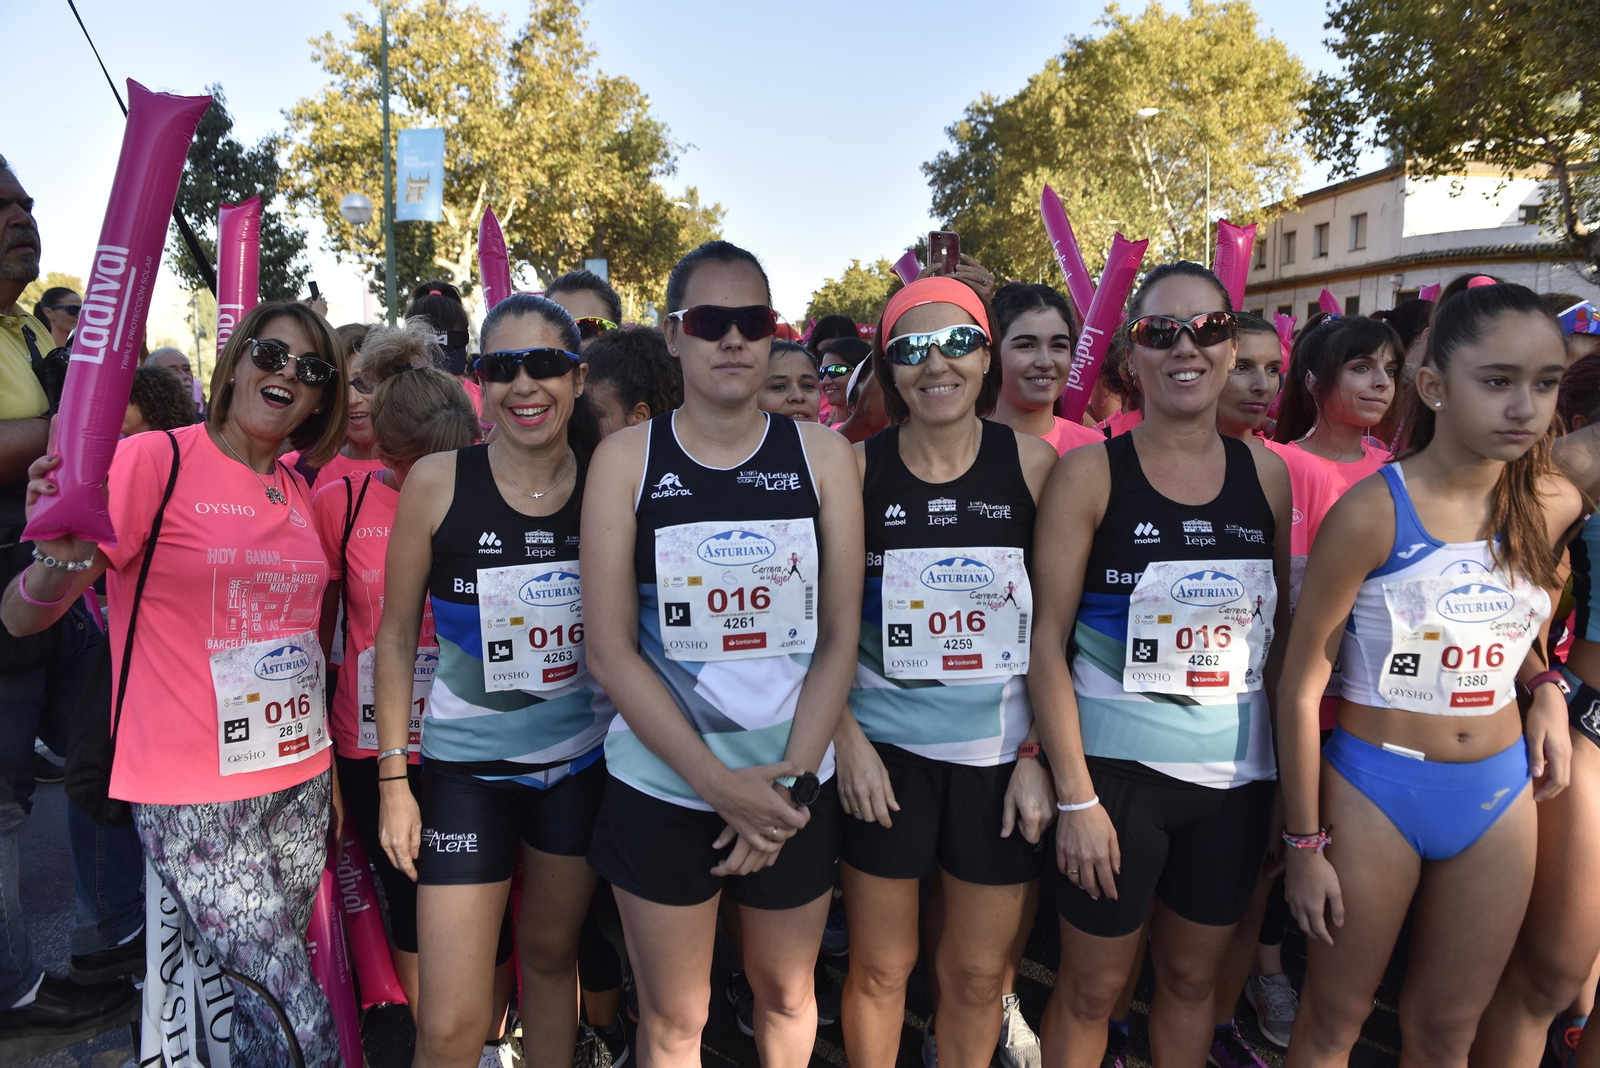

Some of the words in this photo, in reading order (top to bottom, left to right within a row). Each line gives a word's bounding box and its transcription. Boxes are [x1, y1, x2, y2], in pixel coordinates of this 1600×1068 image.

[69, 244, 130, 365] Ladival
[120, 341, 133, 371] TRIPLE
[128, 286, 146, 341] PROTECCIÓN
[142, 255, 153, 285] SOLAR
[1066, 325, 1105, 392] Ladival
[194, 502, 256, 517] OYSHO
[884, 519, 907, 527] mobel
[927, 514, 958, 527] lepe
[1134, 537, 1161, 545] mobel
[1183, 534, 1217, 548] lepe
[206, 548, 238, 565] HOY
[244, 548, 282, 566] GANAN
[524, 546, 556, 559] lepe
[703, 544, 771, 559] ASTURIANA
[361, 569, 381, 584] HOY
[751, 564, 782, 575] Carrera
[256, 572, 285, 583] VITORIA
[291, 574, 319, 584] GASTEIZ
[769, 573, 792, 586] Mujer
[926, 570, 989, 584] ASTURIANA
[269, 583, 299, 593] MADRID
[524, 586, 581, 601] ASTURIAN
[969, 590, 998, 600] Carrera
[1176, 584, 1240, 599] ASTURIANA
[707, 585, 771, 613] 016
[986, 600, 1006, 612] Mujer
[1218, 605, 1248, 615] Carrera
[1443, 599, 1509, 615] ASTURIANA
[266, 619, 280, 632] LAS
[723, 616, 755, 630] 4261
[928, 609, 987, 635] 016
[1489, 620, 1518, 631] Carrera
[528, 622, 585, 649] 016
[735, 638, 762, 646] Santander
[1175, 624, 1232, 650] 016
[669, 640, 708, 650] OYSHO
[943, 638, 973, 651] 4259
[543, 650, 573, 664] 4263
[1188, 654, 1220, 666] 4262
[1441, 643, 1505, 669] 016
[260, 658, 309, 676] ASTURIANA
[891, 659, 929, 669] OYSHO
[492, 671, 530, 681] OYSHO
[553, 667, 575, 677] Santander
[1132, 672, 1171, 683] OYSHO
[1456, 674, 1488, 687] 1380
[1389, 687, 1434, 702] OYSHO
[264, 693, 311, 724] 016
[279, 722, 304, 738] 2819
[227, 750, 266, 764] OYSHO
